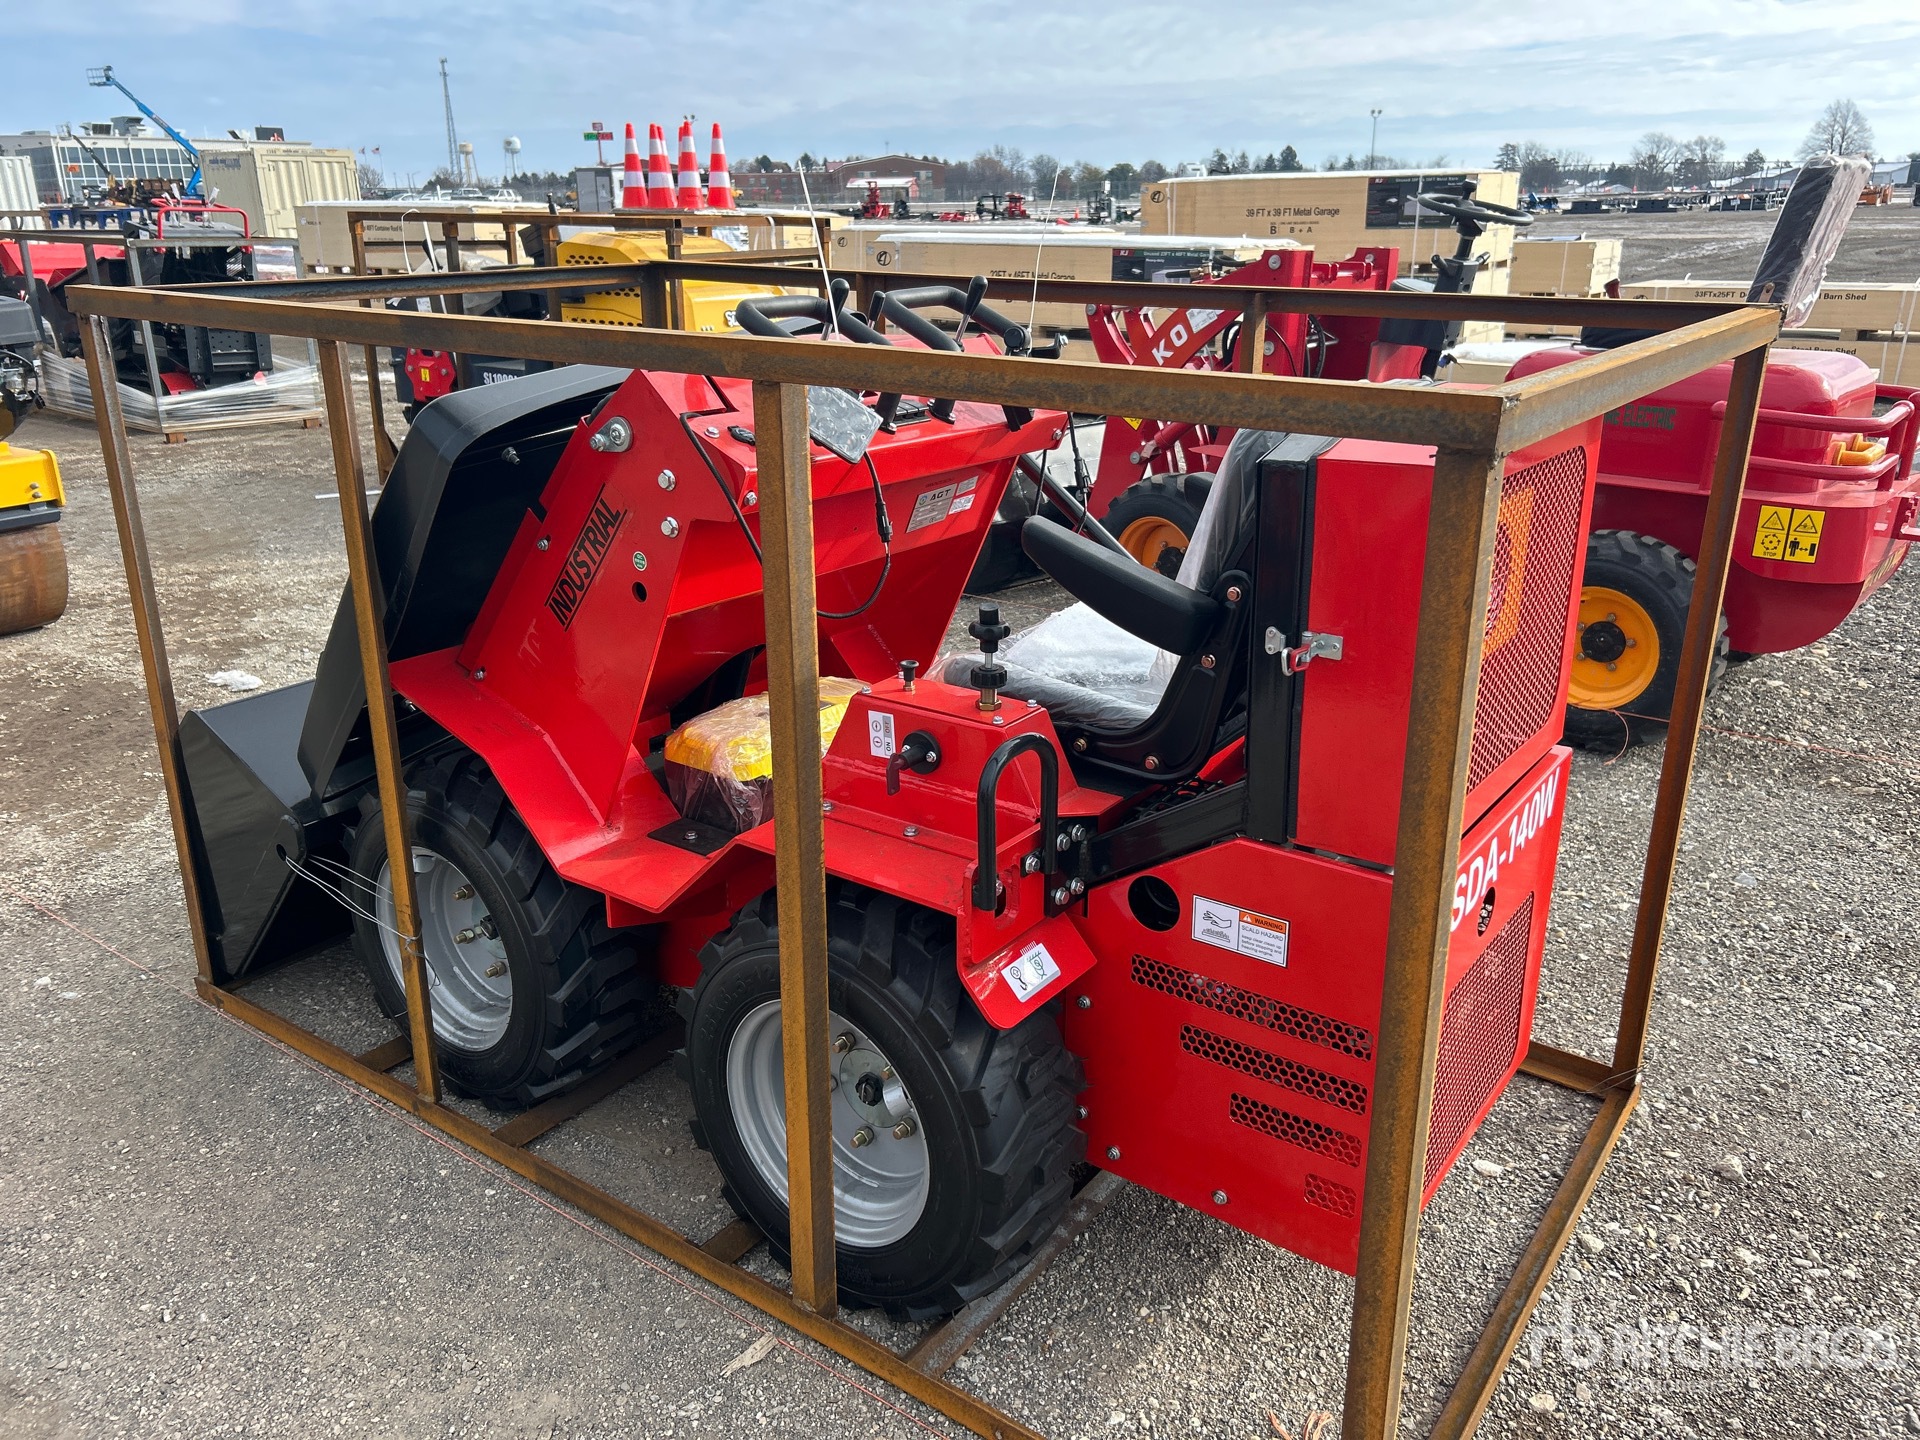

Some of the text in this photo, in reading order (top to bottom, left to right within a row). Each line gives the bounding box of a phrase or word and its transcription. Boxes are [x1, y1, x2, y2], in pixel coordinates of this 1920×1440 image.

[1246, 208, 1255, 217] 39
[1256, 208, 1265, 217] FT
[1272, 208, 1281, 217] 39
[1283, 208, 1292, 217] FT
[1293, 207, 1312, 216] Metal
[1314, 207, 1340, 217] Garage
[1835, 347, 1856, 355] Shed
[1623, 404, 1676, 431] ELECTRIC
[930, 488, 952, 502] AGT
[548, 498, 621, 626] INDUSTRIAL
[886, 742, 892, 752] ON
[1450, 766, 1560, 932] SDA-140W
[1254, 918, 1283, 931] WARNING
[1242, 924, 1284, 942] SCALD HAZARD
